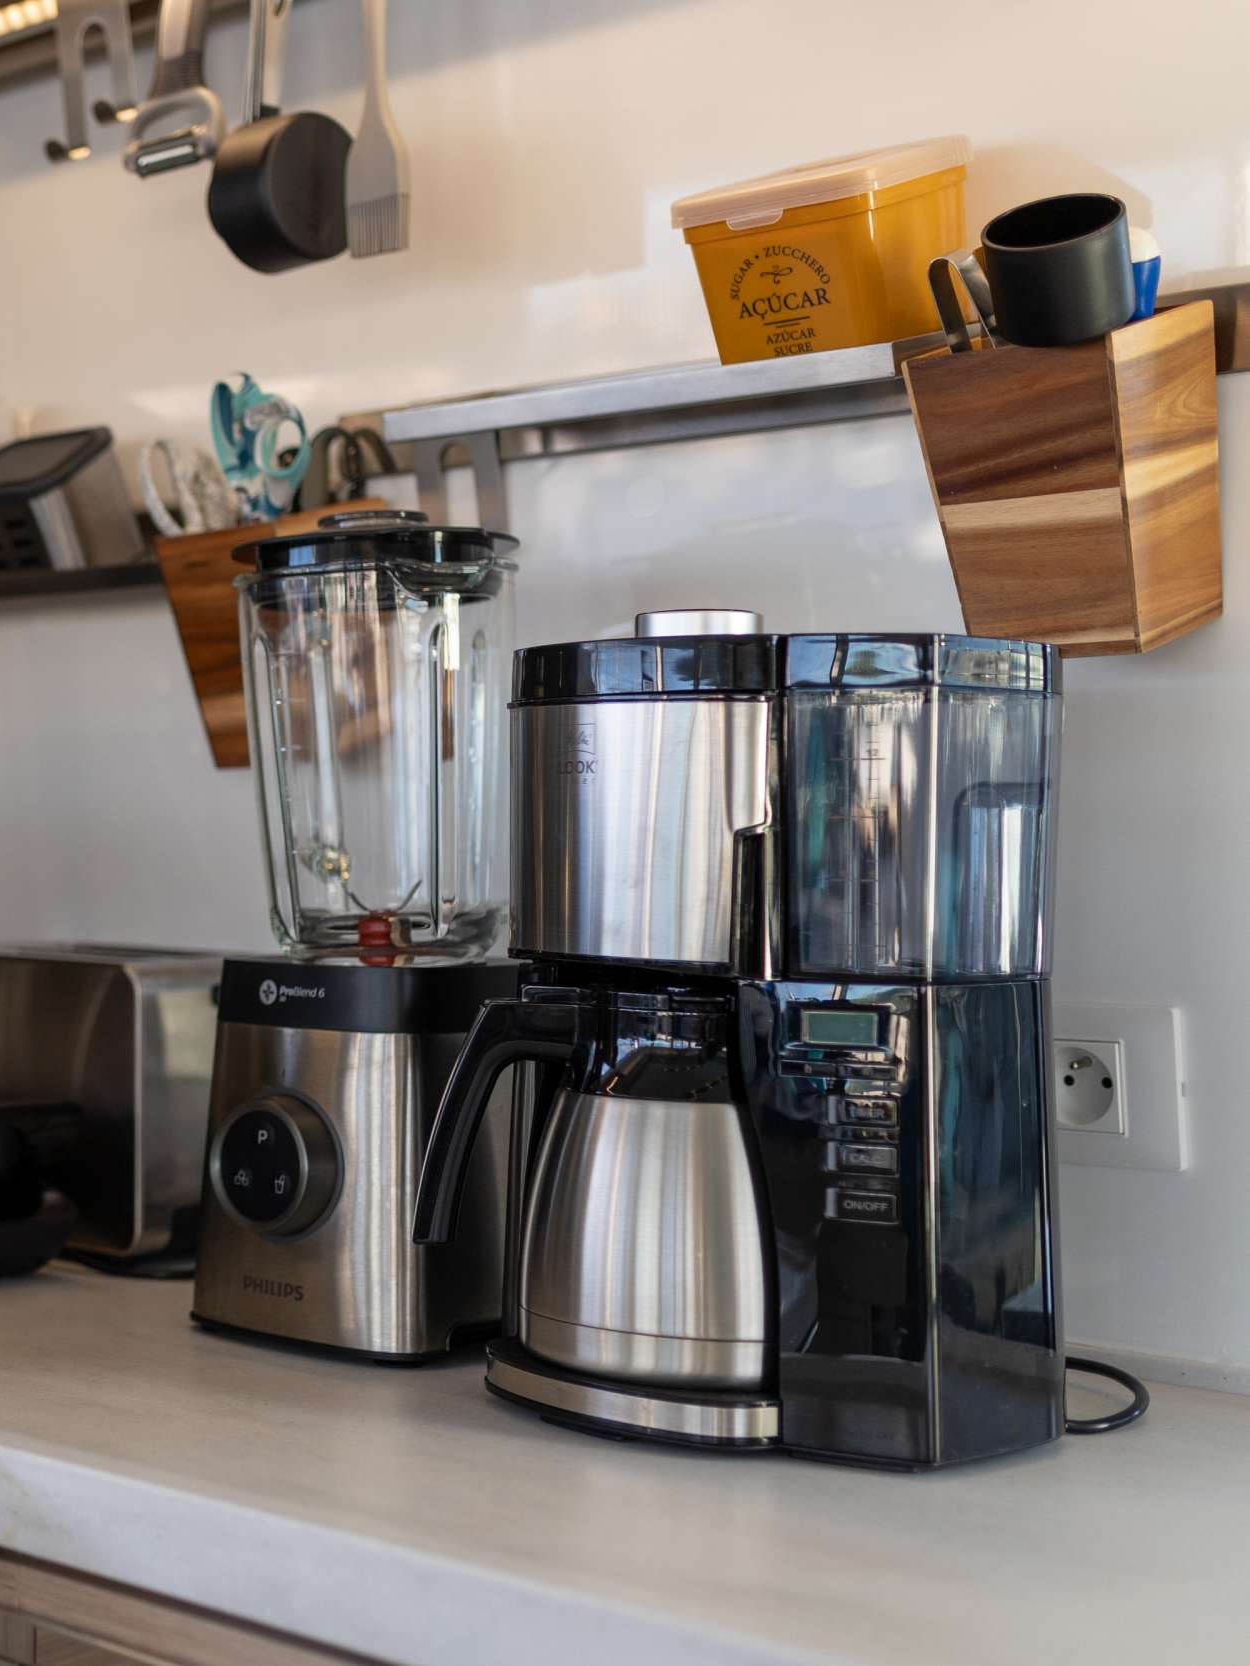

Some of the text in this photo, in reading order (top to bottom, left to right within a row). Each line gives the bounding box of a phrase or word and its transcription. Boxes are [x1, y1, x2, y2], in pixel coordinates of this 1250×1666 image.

[730, 246, 830, 300] SUGAR ZUCCHERO
[739, 288, 831, 320] AÇÚCAR
[766, 327, 816, 345] AZÚCAR
[774, 343, 814, 357] SUCRE
[318, 987, 326, 999] 6
[257, 1129, 269, 1145] P
[844, 1200, 889, 1212] ON/OFF
[244, 1275, 305, 1301] PHILIPS
